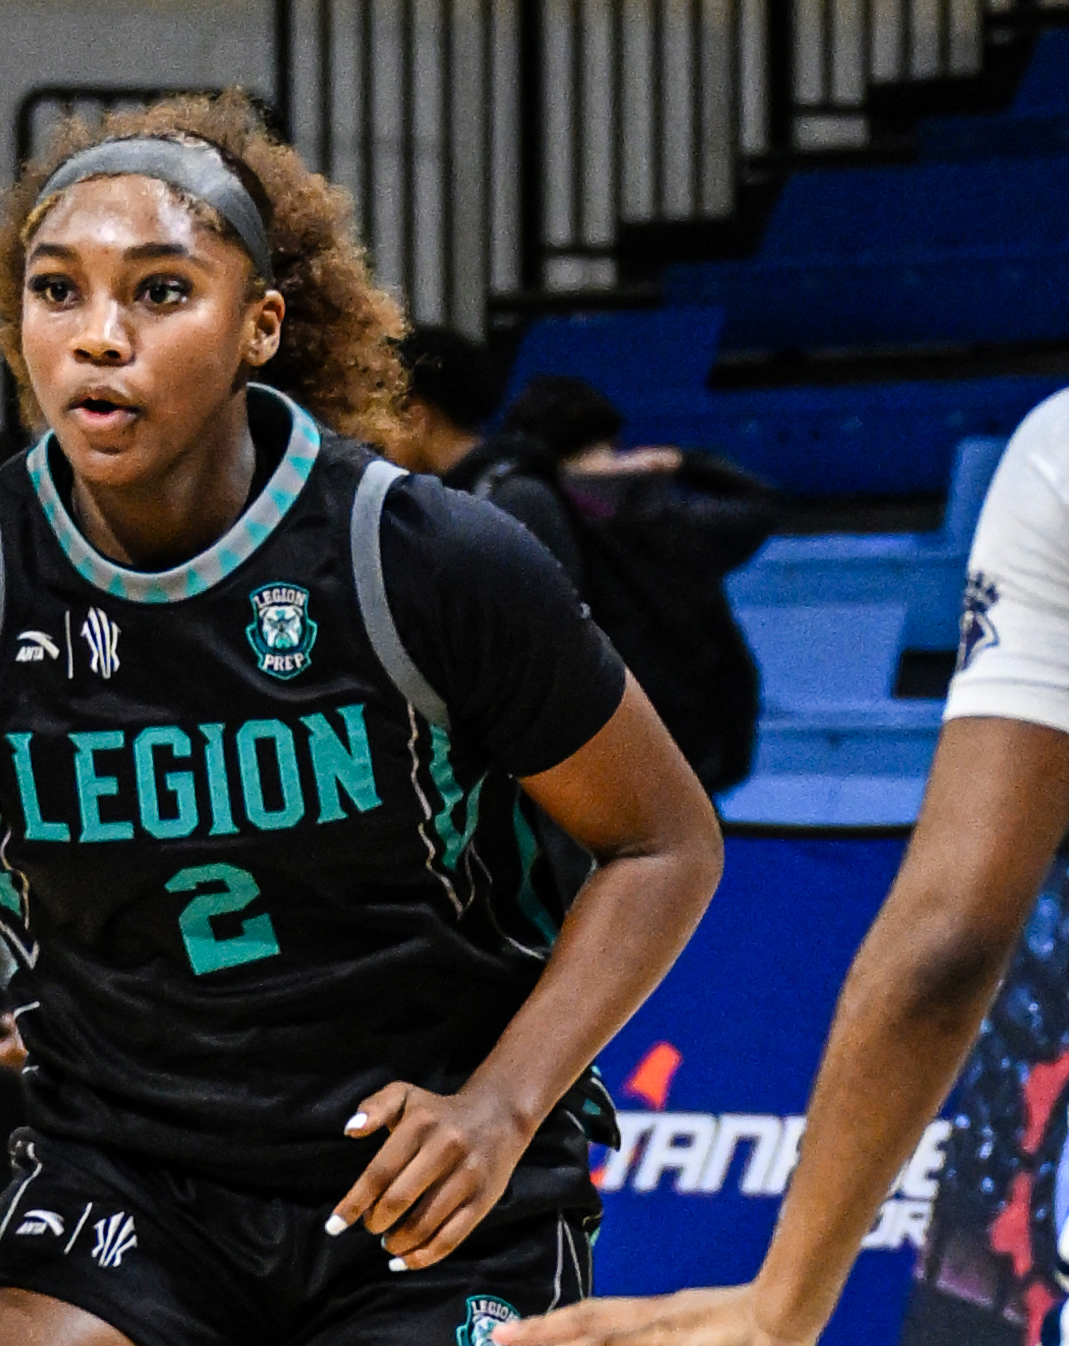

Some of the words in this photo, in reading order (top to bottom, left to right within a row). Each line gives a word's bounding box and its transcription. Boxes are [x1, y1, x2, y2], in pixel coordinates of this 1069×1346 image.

[253, 587, 306, 609] LEGION
[262, 653, 305, 671] PREP
[5, 703, 383, 843] LEGION
[164, 862, 281, 976] 2
